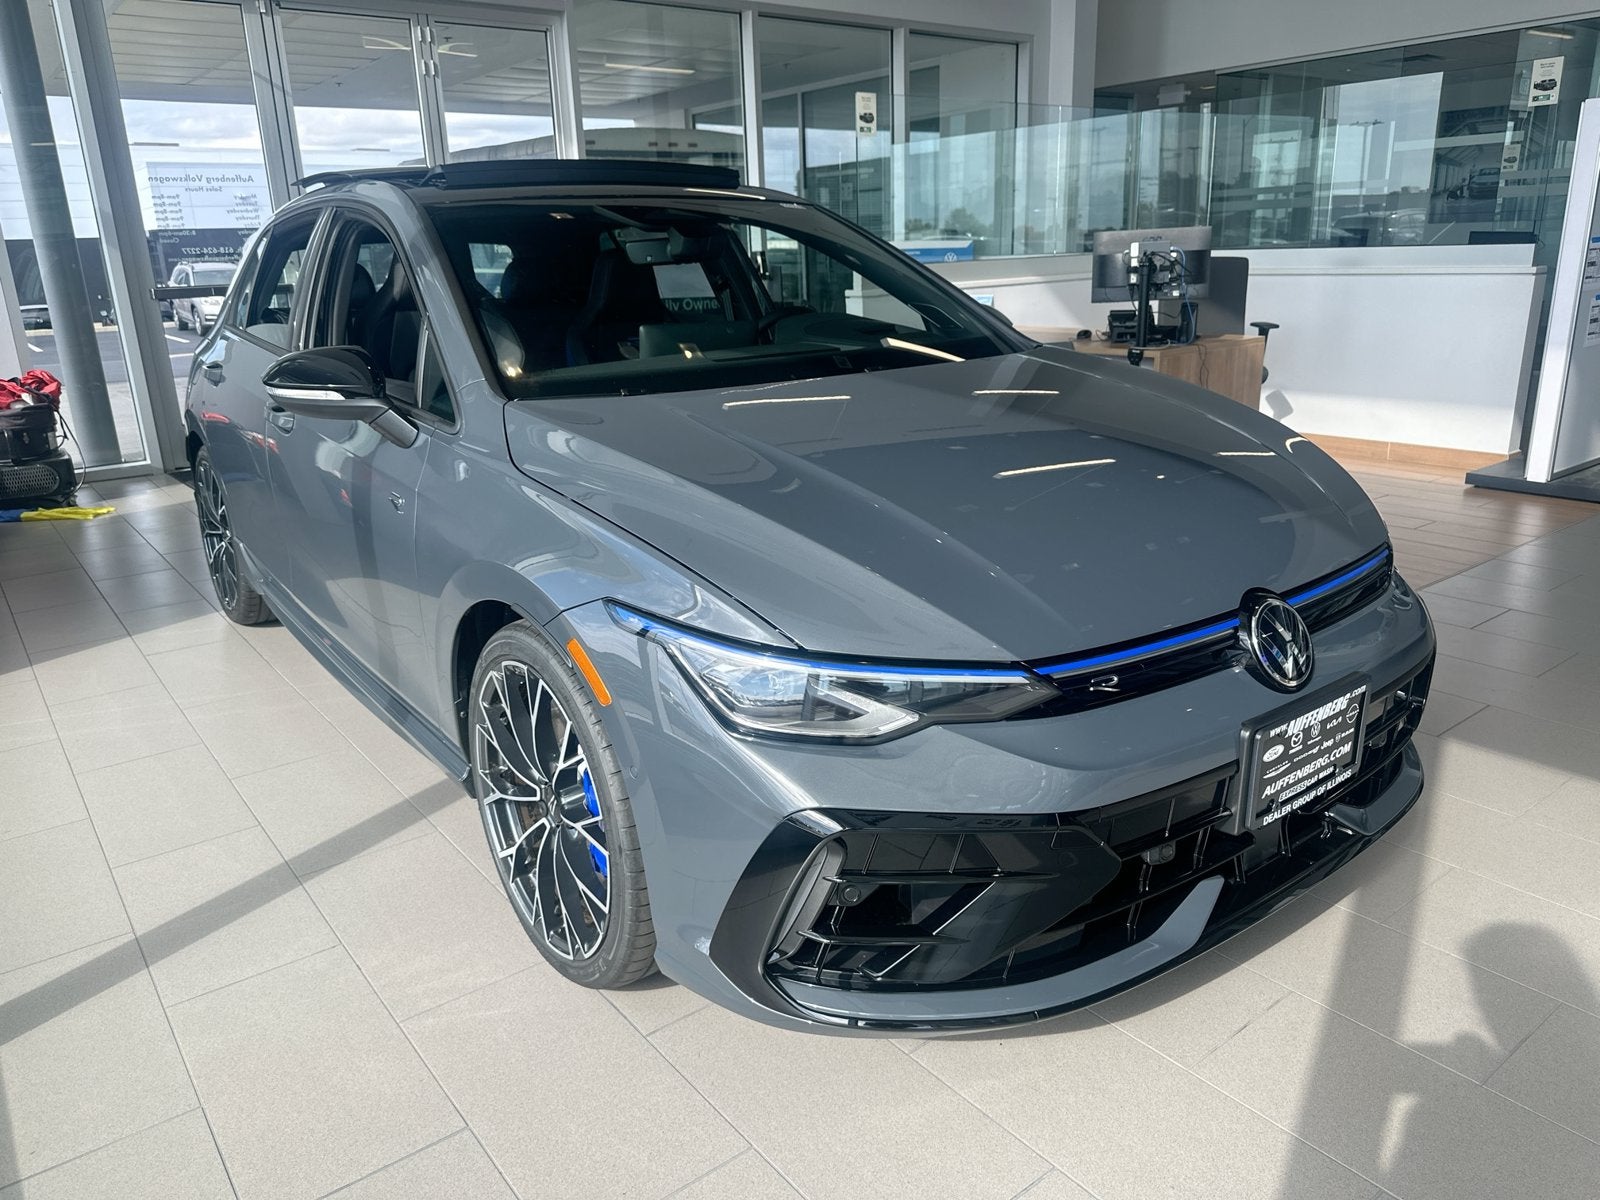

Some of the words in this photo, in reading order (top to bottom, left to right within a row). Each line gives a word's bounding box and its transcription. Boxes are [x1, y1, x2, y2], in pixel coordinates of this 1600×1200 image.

[1321, 738, 1335, 750] Jeep
[1261, 741, 1352, 799] AUFFENBERG.COM
[1279, 782, 1307, 802] EXPRESS
[1306, 774, 1319, 787] CAR
[1318, 765, 1335, 780] WASH
[1263, 804, 1291, 826] DEALER
[1292, 790, 1317, 810] GROUP
[1317, 786, 1327, 796] OF
[1326, 769, 1352, 790] ILLINOIS
